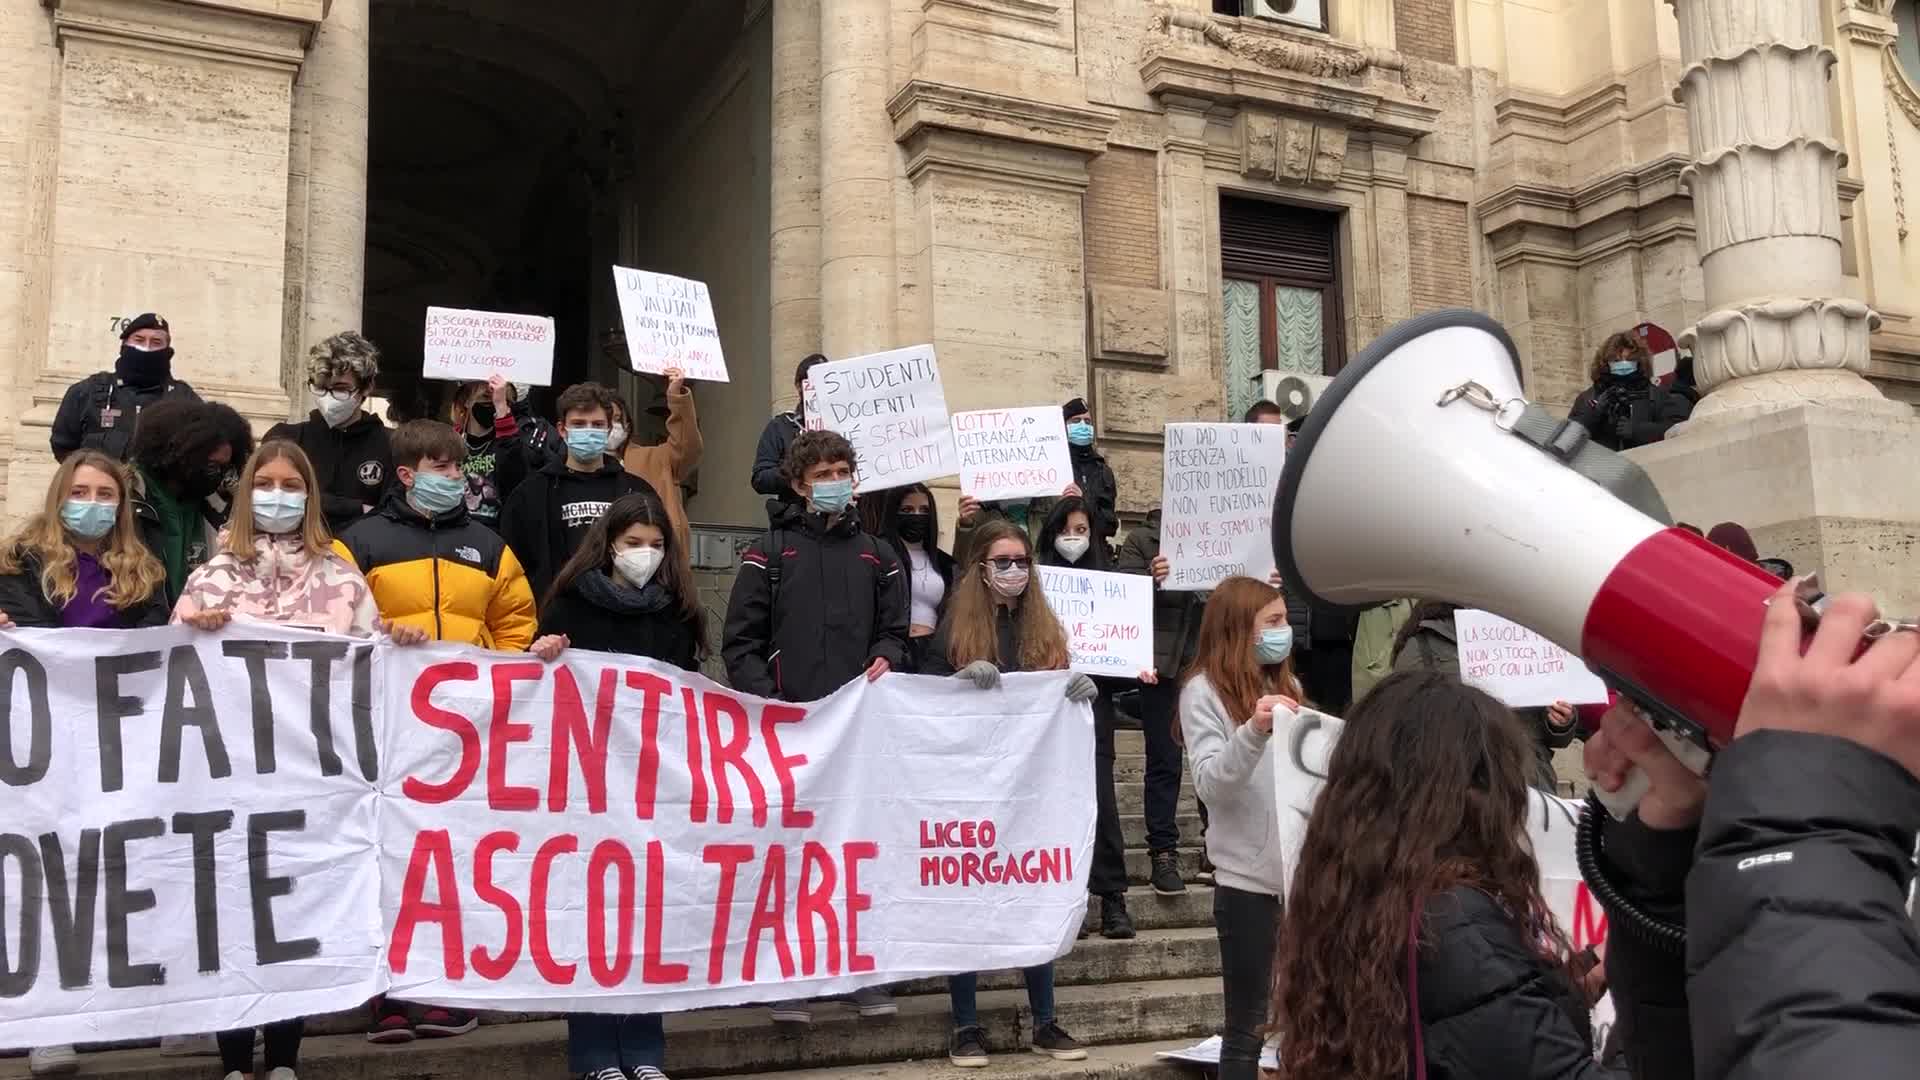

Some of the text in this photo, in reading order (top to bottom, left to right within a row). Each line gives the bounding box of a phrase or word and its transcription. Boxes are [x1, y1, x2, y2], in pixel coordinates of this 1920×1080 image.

[640, 295, 696, 319] VALUTATI
[427, 315, 547, 334] LA SCUOLA PUBBLICA NON
[427, 327, 437, 337] SI
[442, 328, 468, 338] TOCCA
[472, 328, 486, 339] LA
[428, 337, 492, 349] CON LA LOTTA
[823, 358, 935, 395] STUDENTI,
[830, 393, 916, 424] DOCENTI
[870, 415, 929, 448] SERVI
[956, 413, 1036, 431] LOTTA AD
[958, 430, 1030, 448] OLTRANZA
[1169, 429, 1263, 447] IN DAD O IN
[873, 441, 943, 476] CLIENTI
[963, 445, 1049, 467] ALTERNANZA
[1169, 447, 1249, 469] PRESENZA IL
[972, 468, 1057, 489] #IOSCIOPERO
[1168, 466, 1267, 492] VOSTRO MODELLO
[1172, 496, 1198, 515] NON
[1166, 521, 1192, 539] NON
[1199, 521, 1211, 536] VE
[1176, 542, 1184, 560] A
[1042, 571, 1127, 601] ZZOLINA HAI
[1047, 593, 1094, 619] LLITO!
[1072, 621, 1140, 641] VE STAMO
[1464, 625, 1479, 643] LA
[1482, 625, 1529, 642] SCUOLA
[1072, 641, 1108, 653] SEGUI
[1466, 649, 1489, 664] NON
[1493, 648, 1503, 661] SI
[1505, 646, 1538, 660] TOCCA
[1543, 646, 1554, 660] LA
[1070, 652, 1127, 666] OSCIOPERO
[1500, 662, 1521, 677] CON
[1524, 663, 1535, 676] LA
[1537, 659, 1565, 675] LOTTA
[95, 640, 379, 792] FATTI
[402, 661, 816, 829] SENTIRE
[920, 820, 996, 848] LICEO
[920, 847, 1073, 887] MORGAGNI
[0, 809, 321, 998] OVETE
[387, 828, 879, 988] ASCOLTARE
